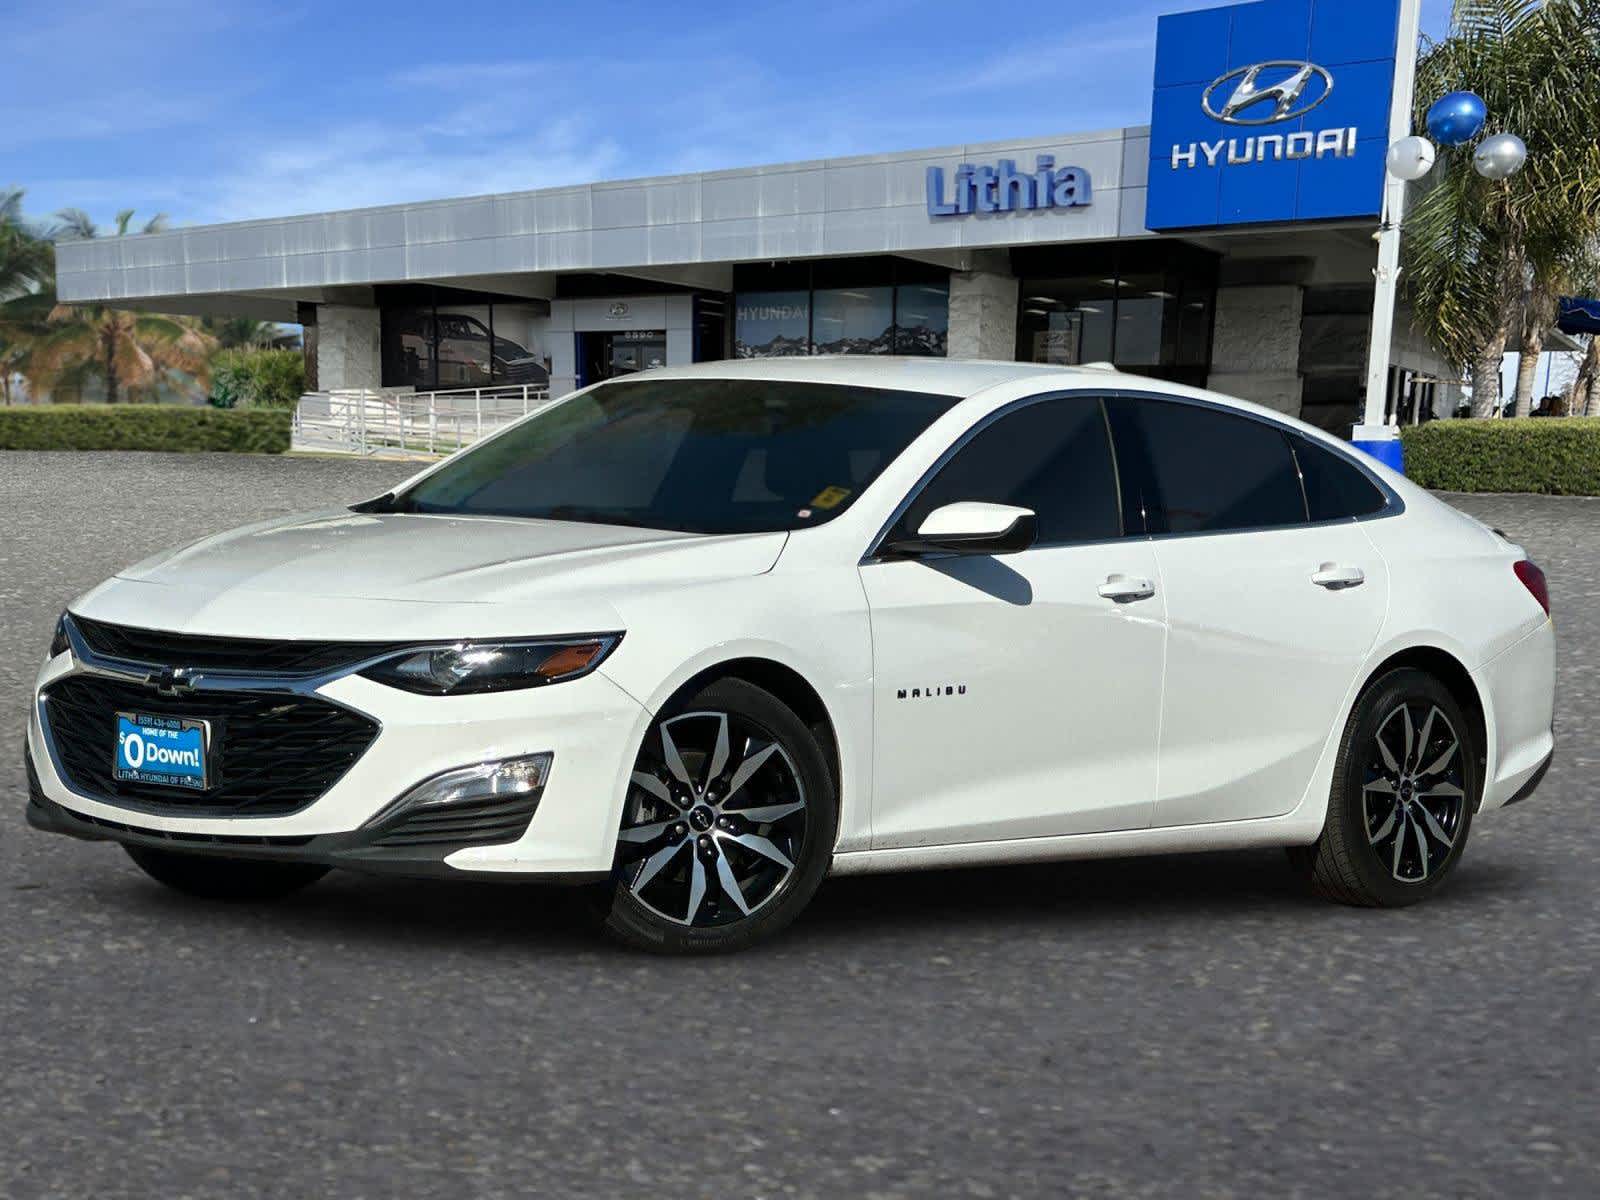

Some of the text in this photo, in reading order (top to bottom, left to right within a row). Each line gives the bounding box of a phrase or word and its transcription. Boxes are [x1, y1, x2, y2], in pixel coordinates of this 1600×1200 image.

[1171, 127, 1357, 169] HYUNDAI
[926, 154, 1092, 217] Lithia
[737, 305, 808, 321] HYUNDAI
[897, 685, 966, 699] MALIBU
[142, 727, 179, 739] HOME OF THE
[146, 742, 200, 767] Down!
